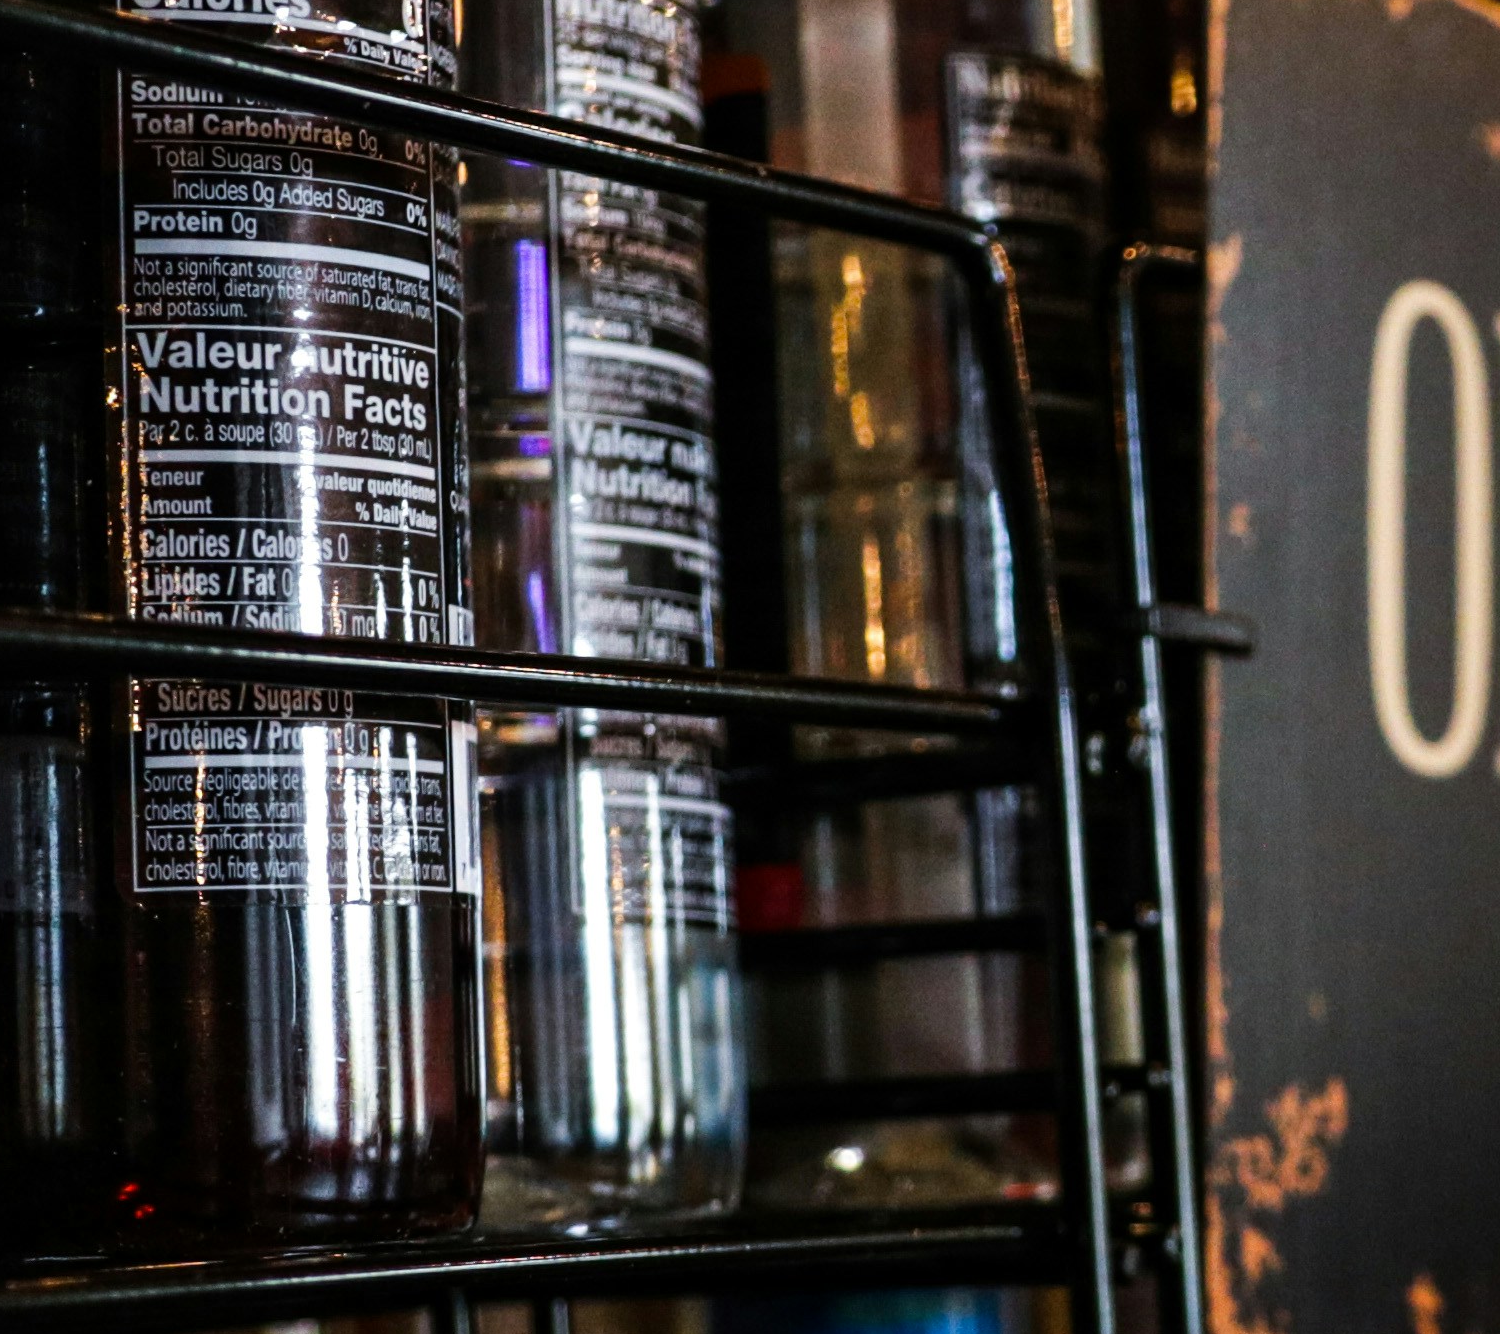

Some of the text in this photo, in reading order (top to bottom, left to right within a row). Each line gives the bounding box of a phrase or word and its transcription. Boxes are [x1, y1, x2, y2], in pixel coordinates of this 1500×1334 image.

[343, 37, 358, 56] %
[360, 41, 391, 66] Daily
[131, 80, 224, 105] Sodium
[131, 113, 195, 135] Total
[202, 114, 353, 148] Carbohydrate
[405, 138, 427, 165] 0%
[152, 144, 314, 178] Total Sugars 0g
[172, 177, 428, 229] Includes 0g Added Sugars 0%
[134, 211, 258, 240] Protein 0g
[133, 257, 417, 298] Not a significant source of saturated fat, trans
[133, 279, 220, 300] cholesterol,
[223, 281, 274, 306] dietary
[314, 286, 359, 309] vitamin
[361, 289, 374, 312] D,
[375, 293, 415, 319] calcium,
[134, 299, 248, 322] and potassium.
[137, 331, 430, 390] Valeur nutritive
[138, 377, 427, 432] Nutrition Facts
[140, 419, 432, 463] Par 2 c. à soupe (30 Per 2 tbsp (30 mL)
[568, 417, 669, 463] Valeur
[140, 465, 437, 504] Teneur valeur quotidienne
[570, 457, 696, 507] Nutrition
[141, 494, 437, 531] Amount % Daily Value
[141, 528, 231, 558] Calories
[141, 566, 277, 600] Lipides Fat
[157, 682, 322, 717] Sucres Sugars
[145, 721, 248, 752] Protéines
[143, 769, 300, 793] Source de
[223, 800, 261, 823] fibres,
[145, 830, 185, 852] Not a
[228, 857, 264, 882] fibre,
